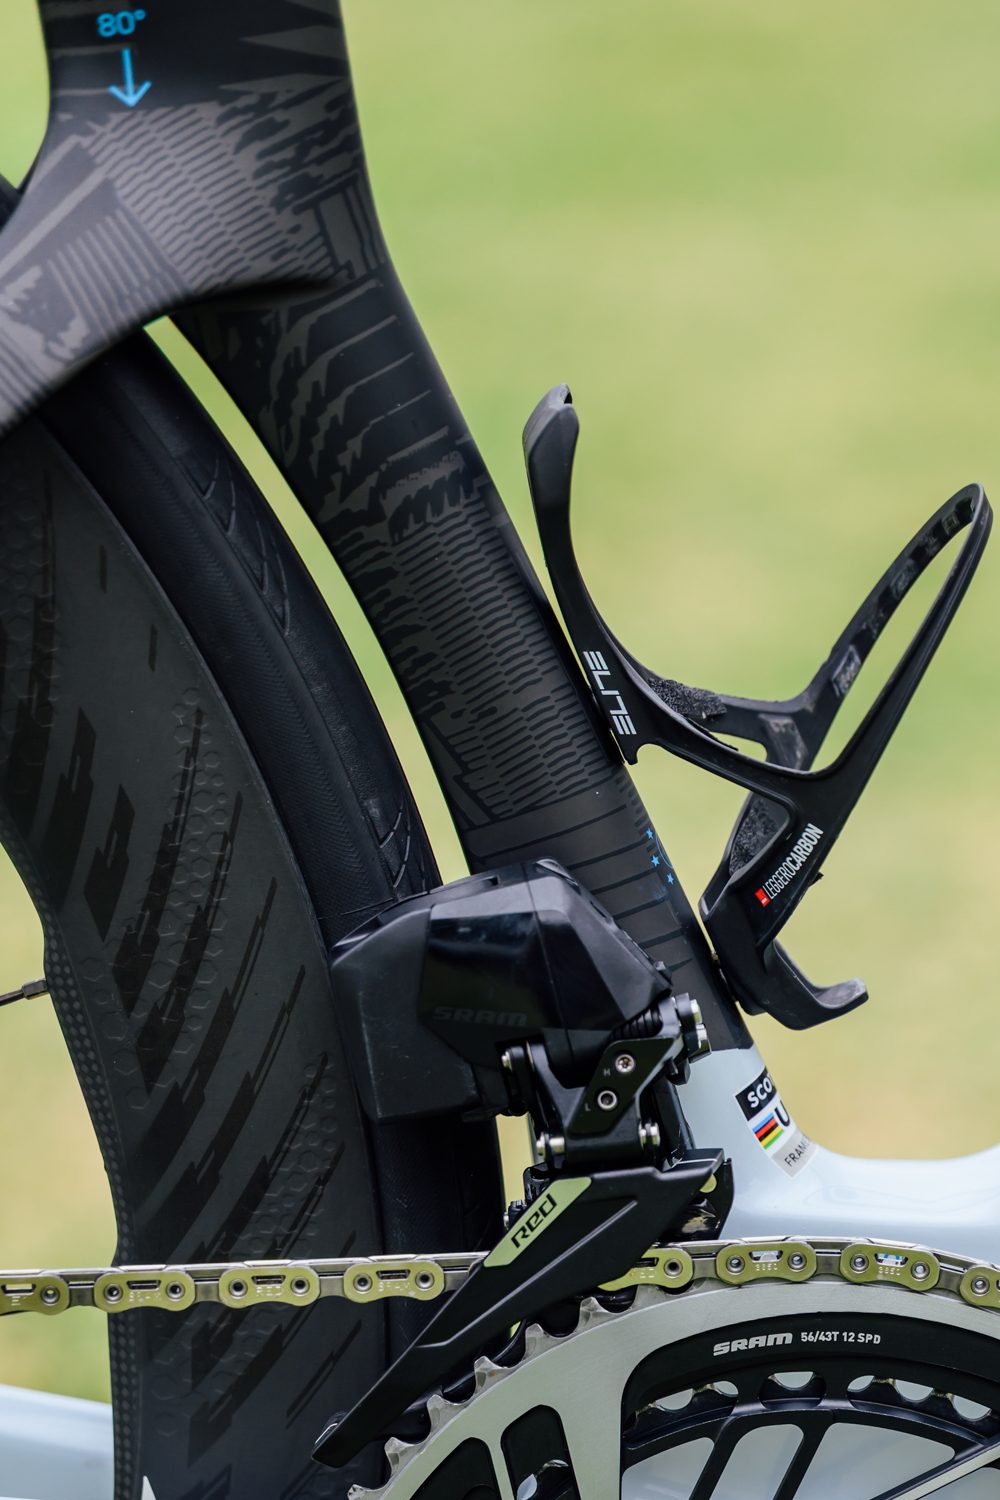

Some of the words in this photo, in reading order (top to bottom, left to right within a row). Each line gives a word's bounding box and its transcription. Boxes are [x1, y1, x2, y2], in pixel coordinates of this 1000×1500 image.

[583, 651, 637, 735] ELITE
[762, 823, 824, 900] LEGGEROCARBON
[433, 1006, 528, 1027] SRAM
[747, 1072, 775, 1108] SCO
[713, 1332, 793, 1356] SRAM
[801, 1331, 839, 1343] 56/43T
[842, 1331, 855, 1342] 12
[857, 1332, 881, 1344] SPD
